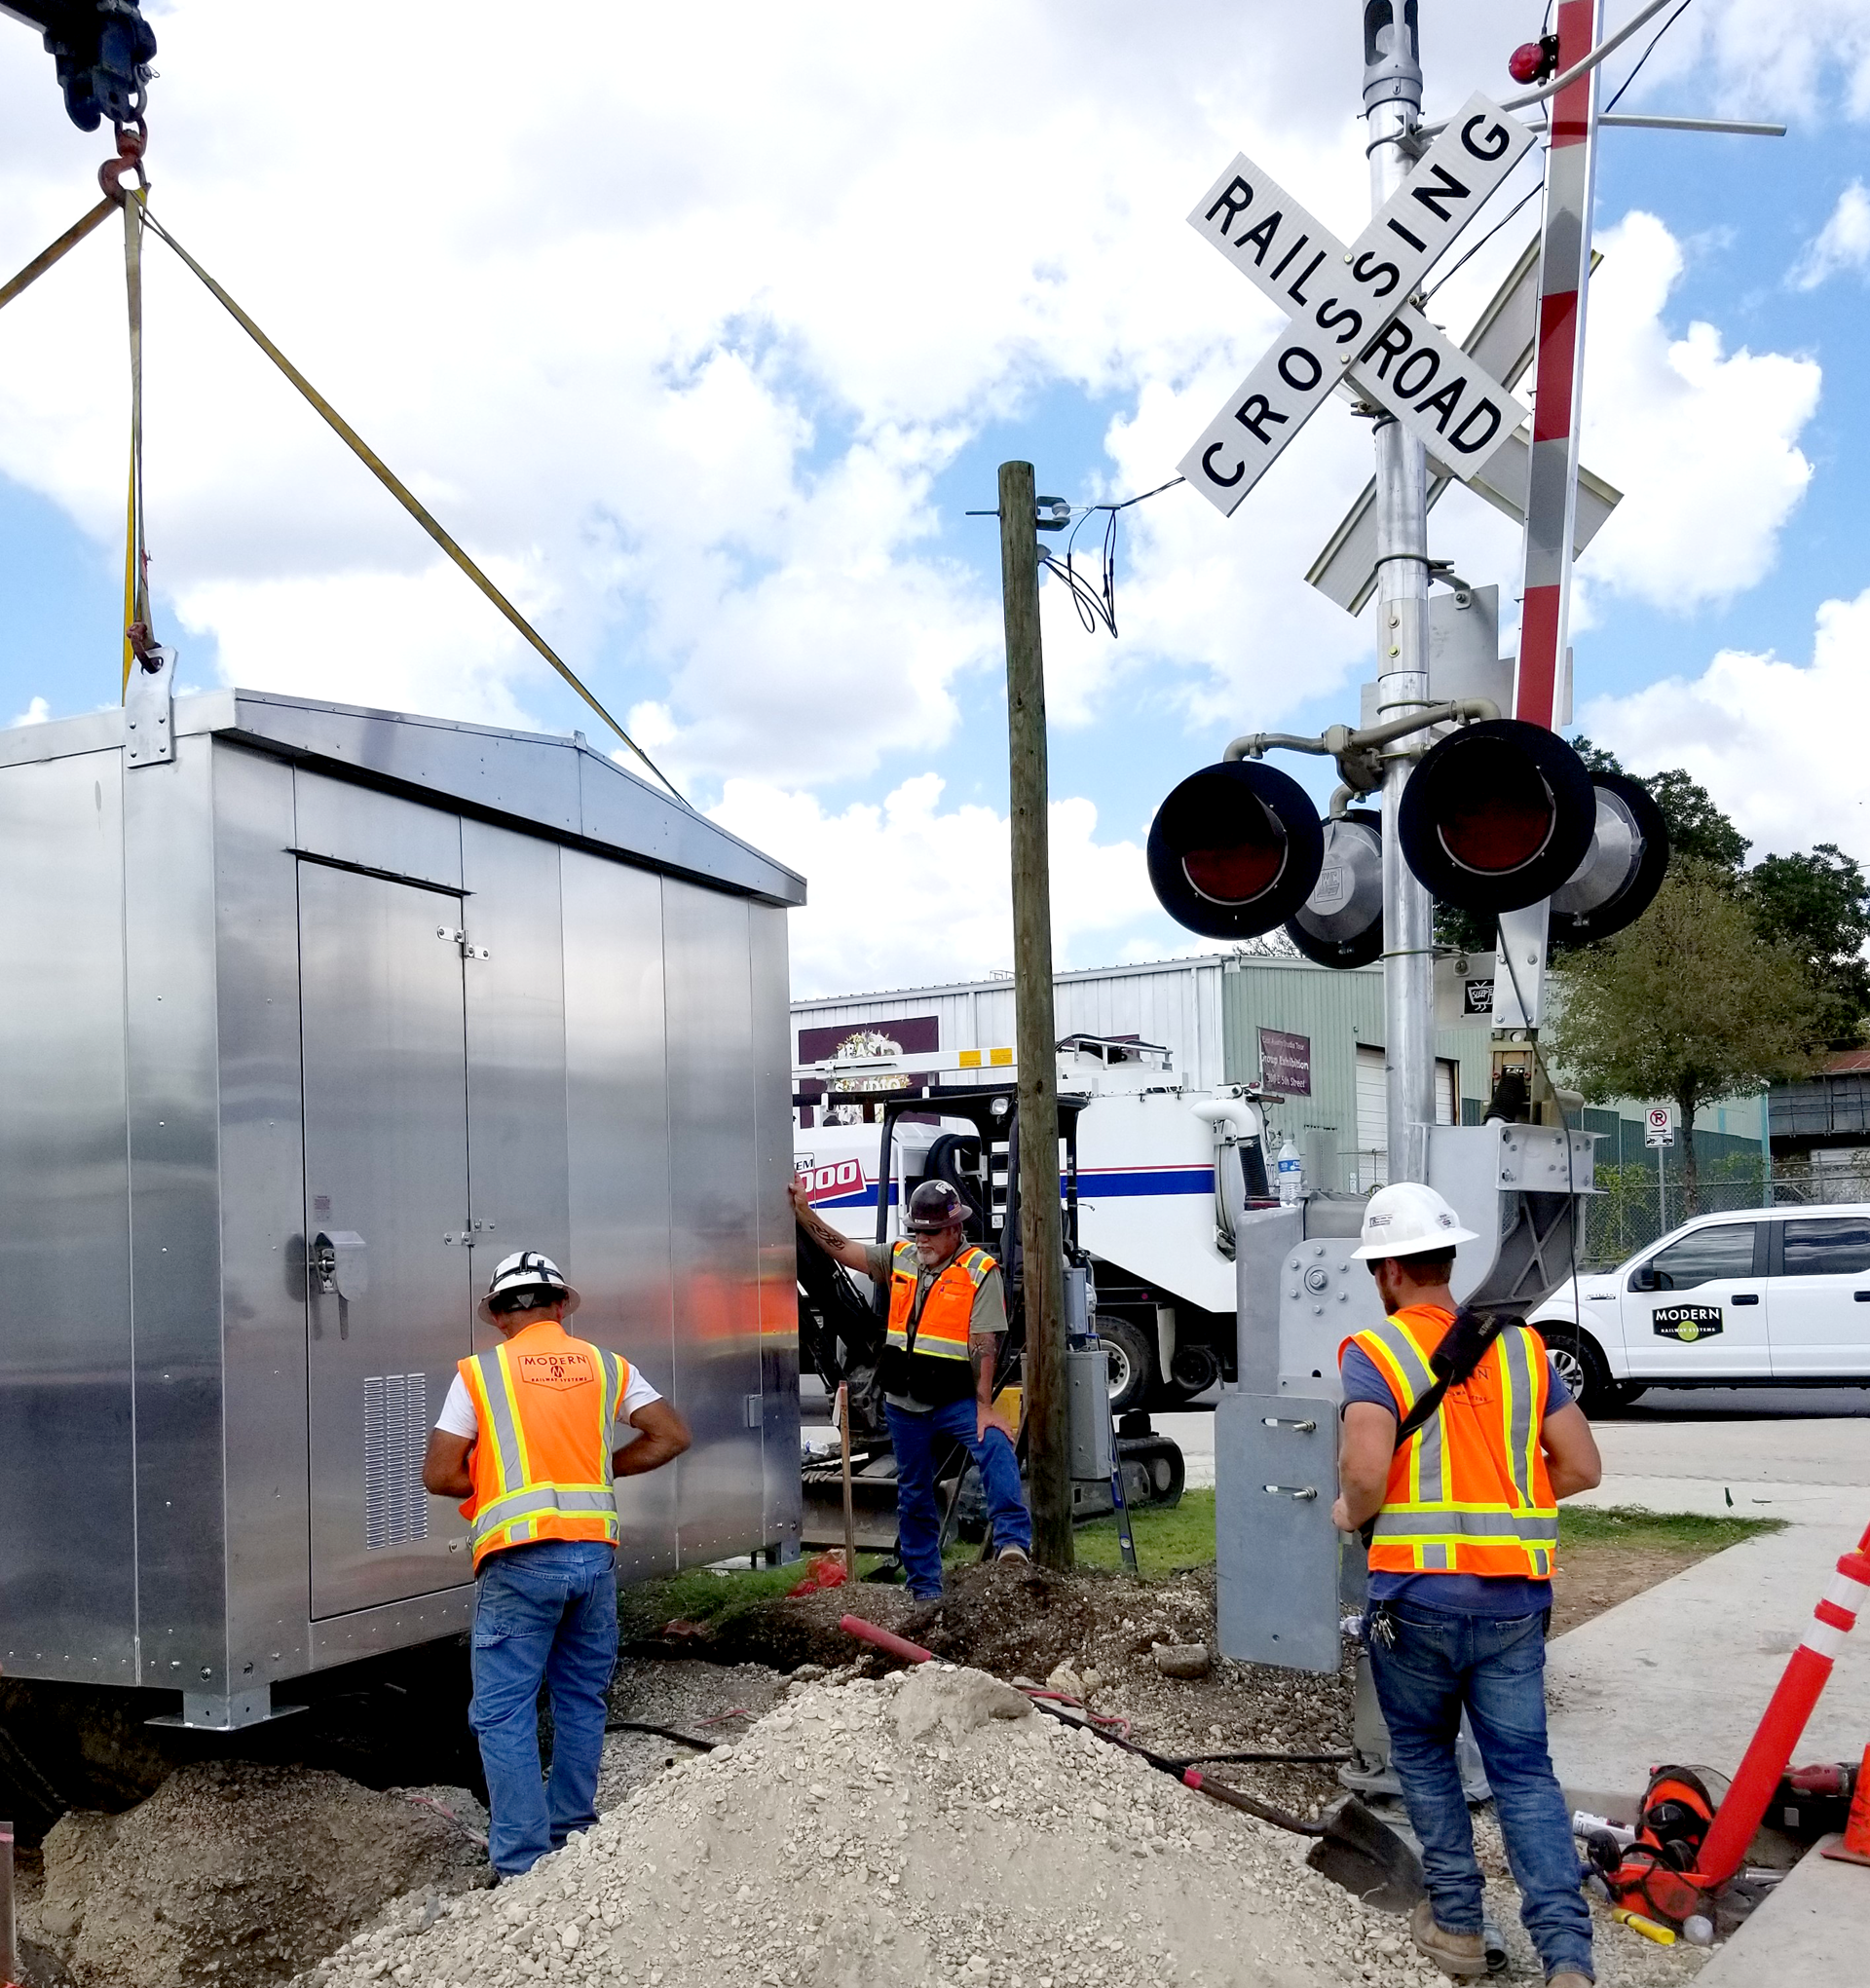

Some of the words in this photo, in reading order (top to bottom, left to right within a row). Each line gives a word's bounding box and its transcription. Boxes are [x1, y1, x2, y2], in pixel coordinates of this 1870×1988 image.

[1201, 113, 1511, 488] CROSSING
[1204, 174, 1328, 308] RAIL
[1359, 316, 1503, 455] ROAD
[1279, 1056, 1309, 1070] Exhibition
[1290, 1076, 1305, 1088] Street
[794, 1159, 813, 1171] EM
[1656, 1308, 1720, 1321] MODERN
[524, 1355, 587, 1366] MODERN
